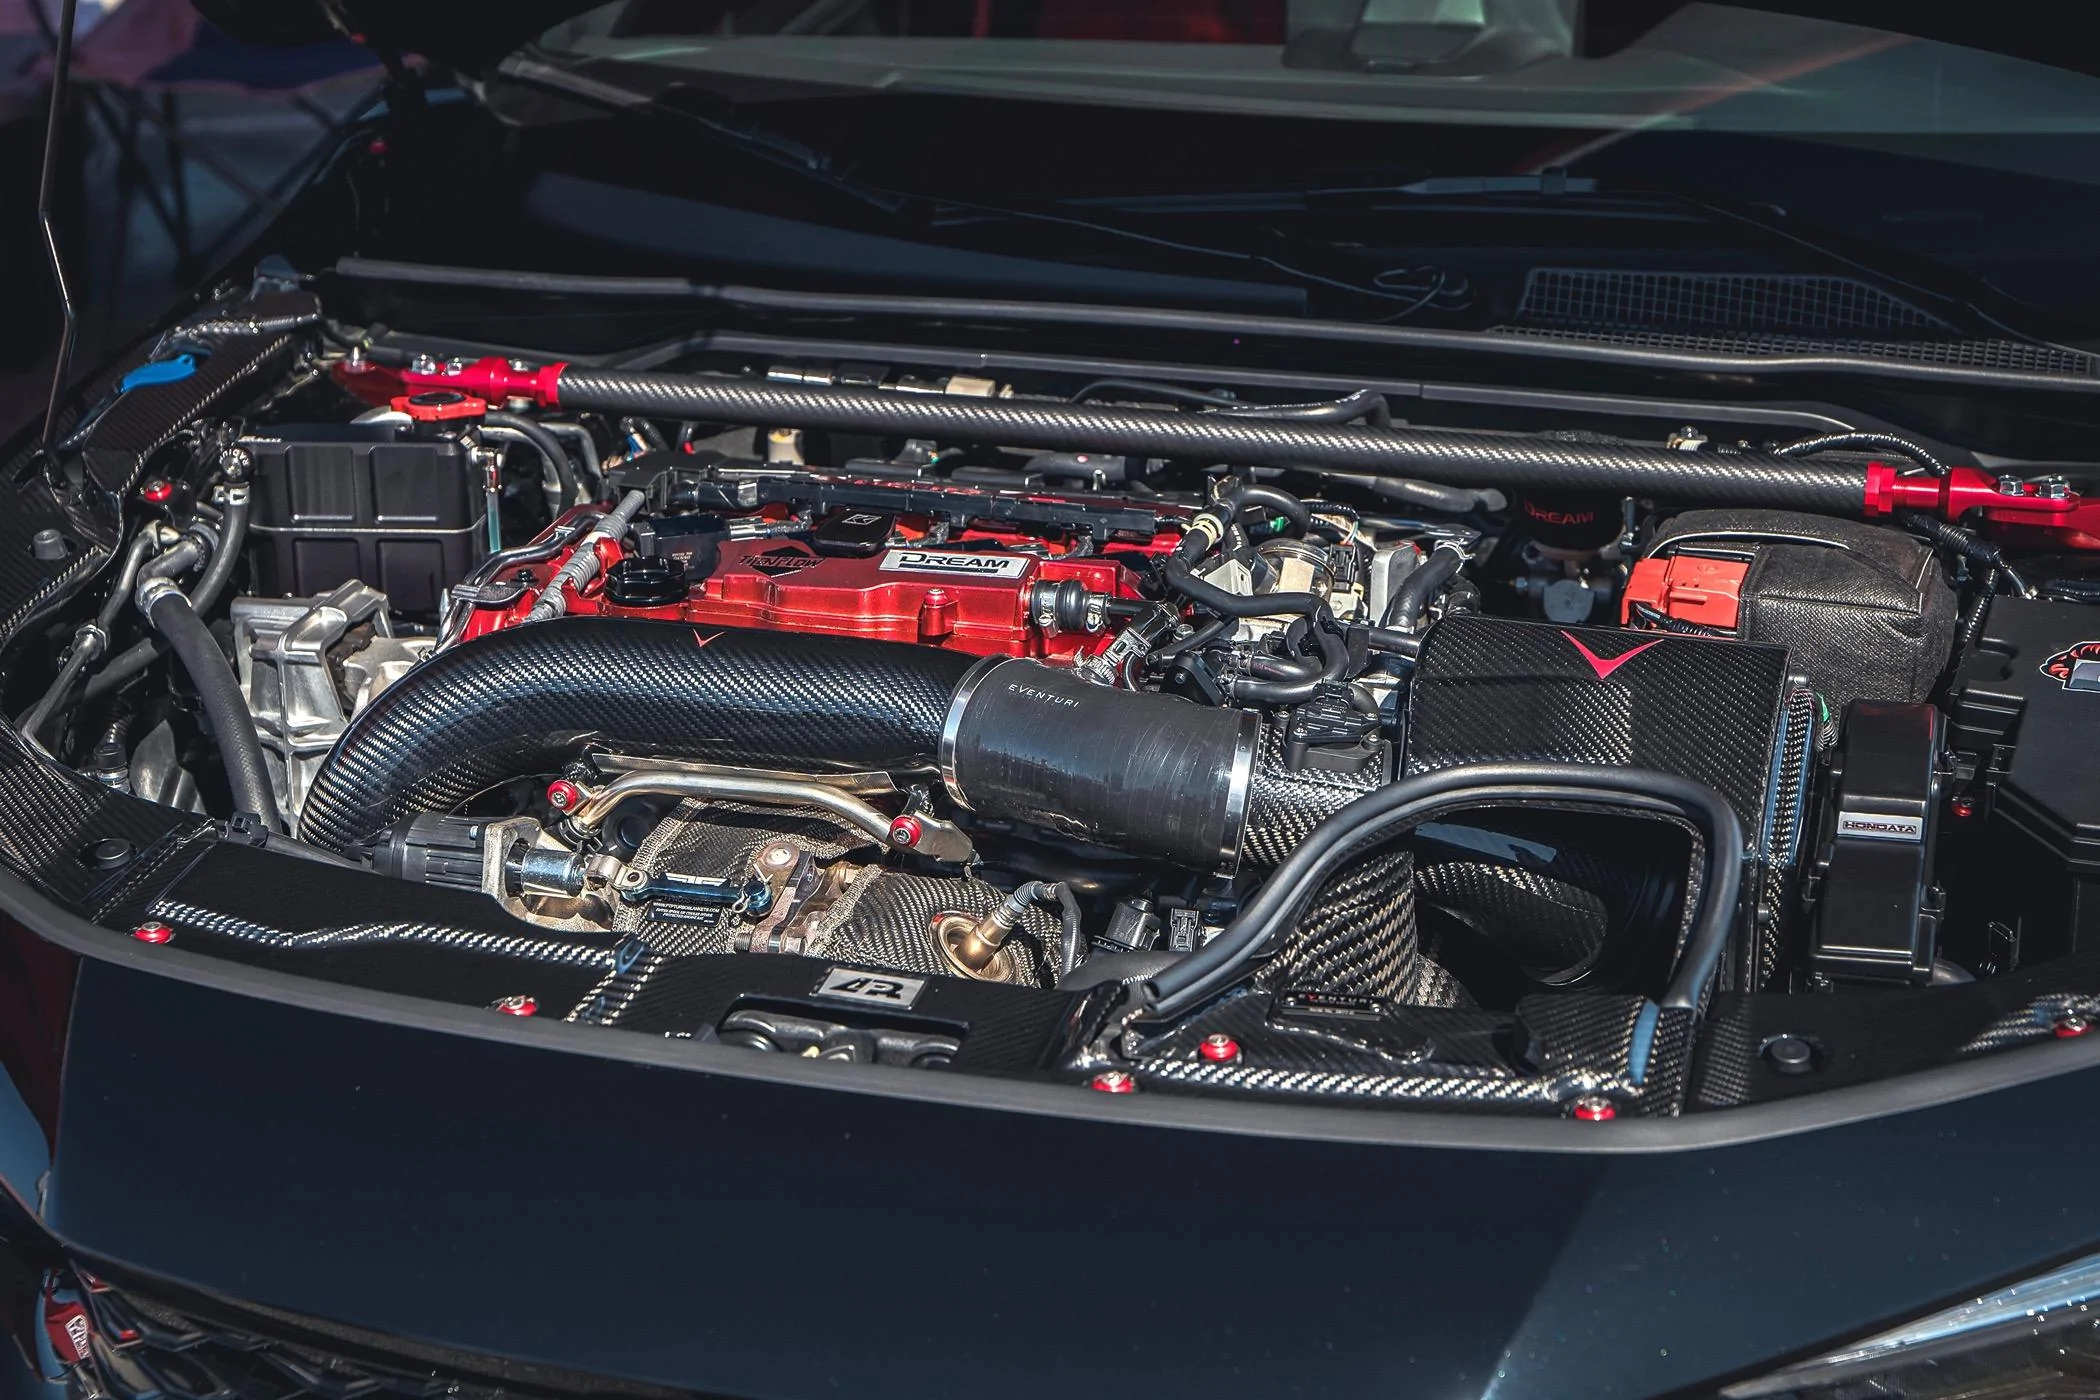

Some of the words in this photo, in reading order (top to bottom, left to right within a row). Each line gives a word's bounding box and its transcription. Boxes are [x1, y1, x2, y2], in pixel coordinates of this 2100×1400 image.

[1524, 500, 1595, 525] DREAM
[899, 552, 1010, 569] DREAM
[1008, 683, 1080, 708] EVENTURI
[1843, 820, 1919, 835] HONDATA
